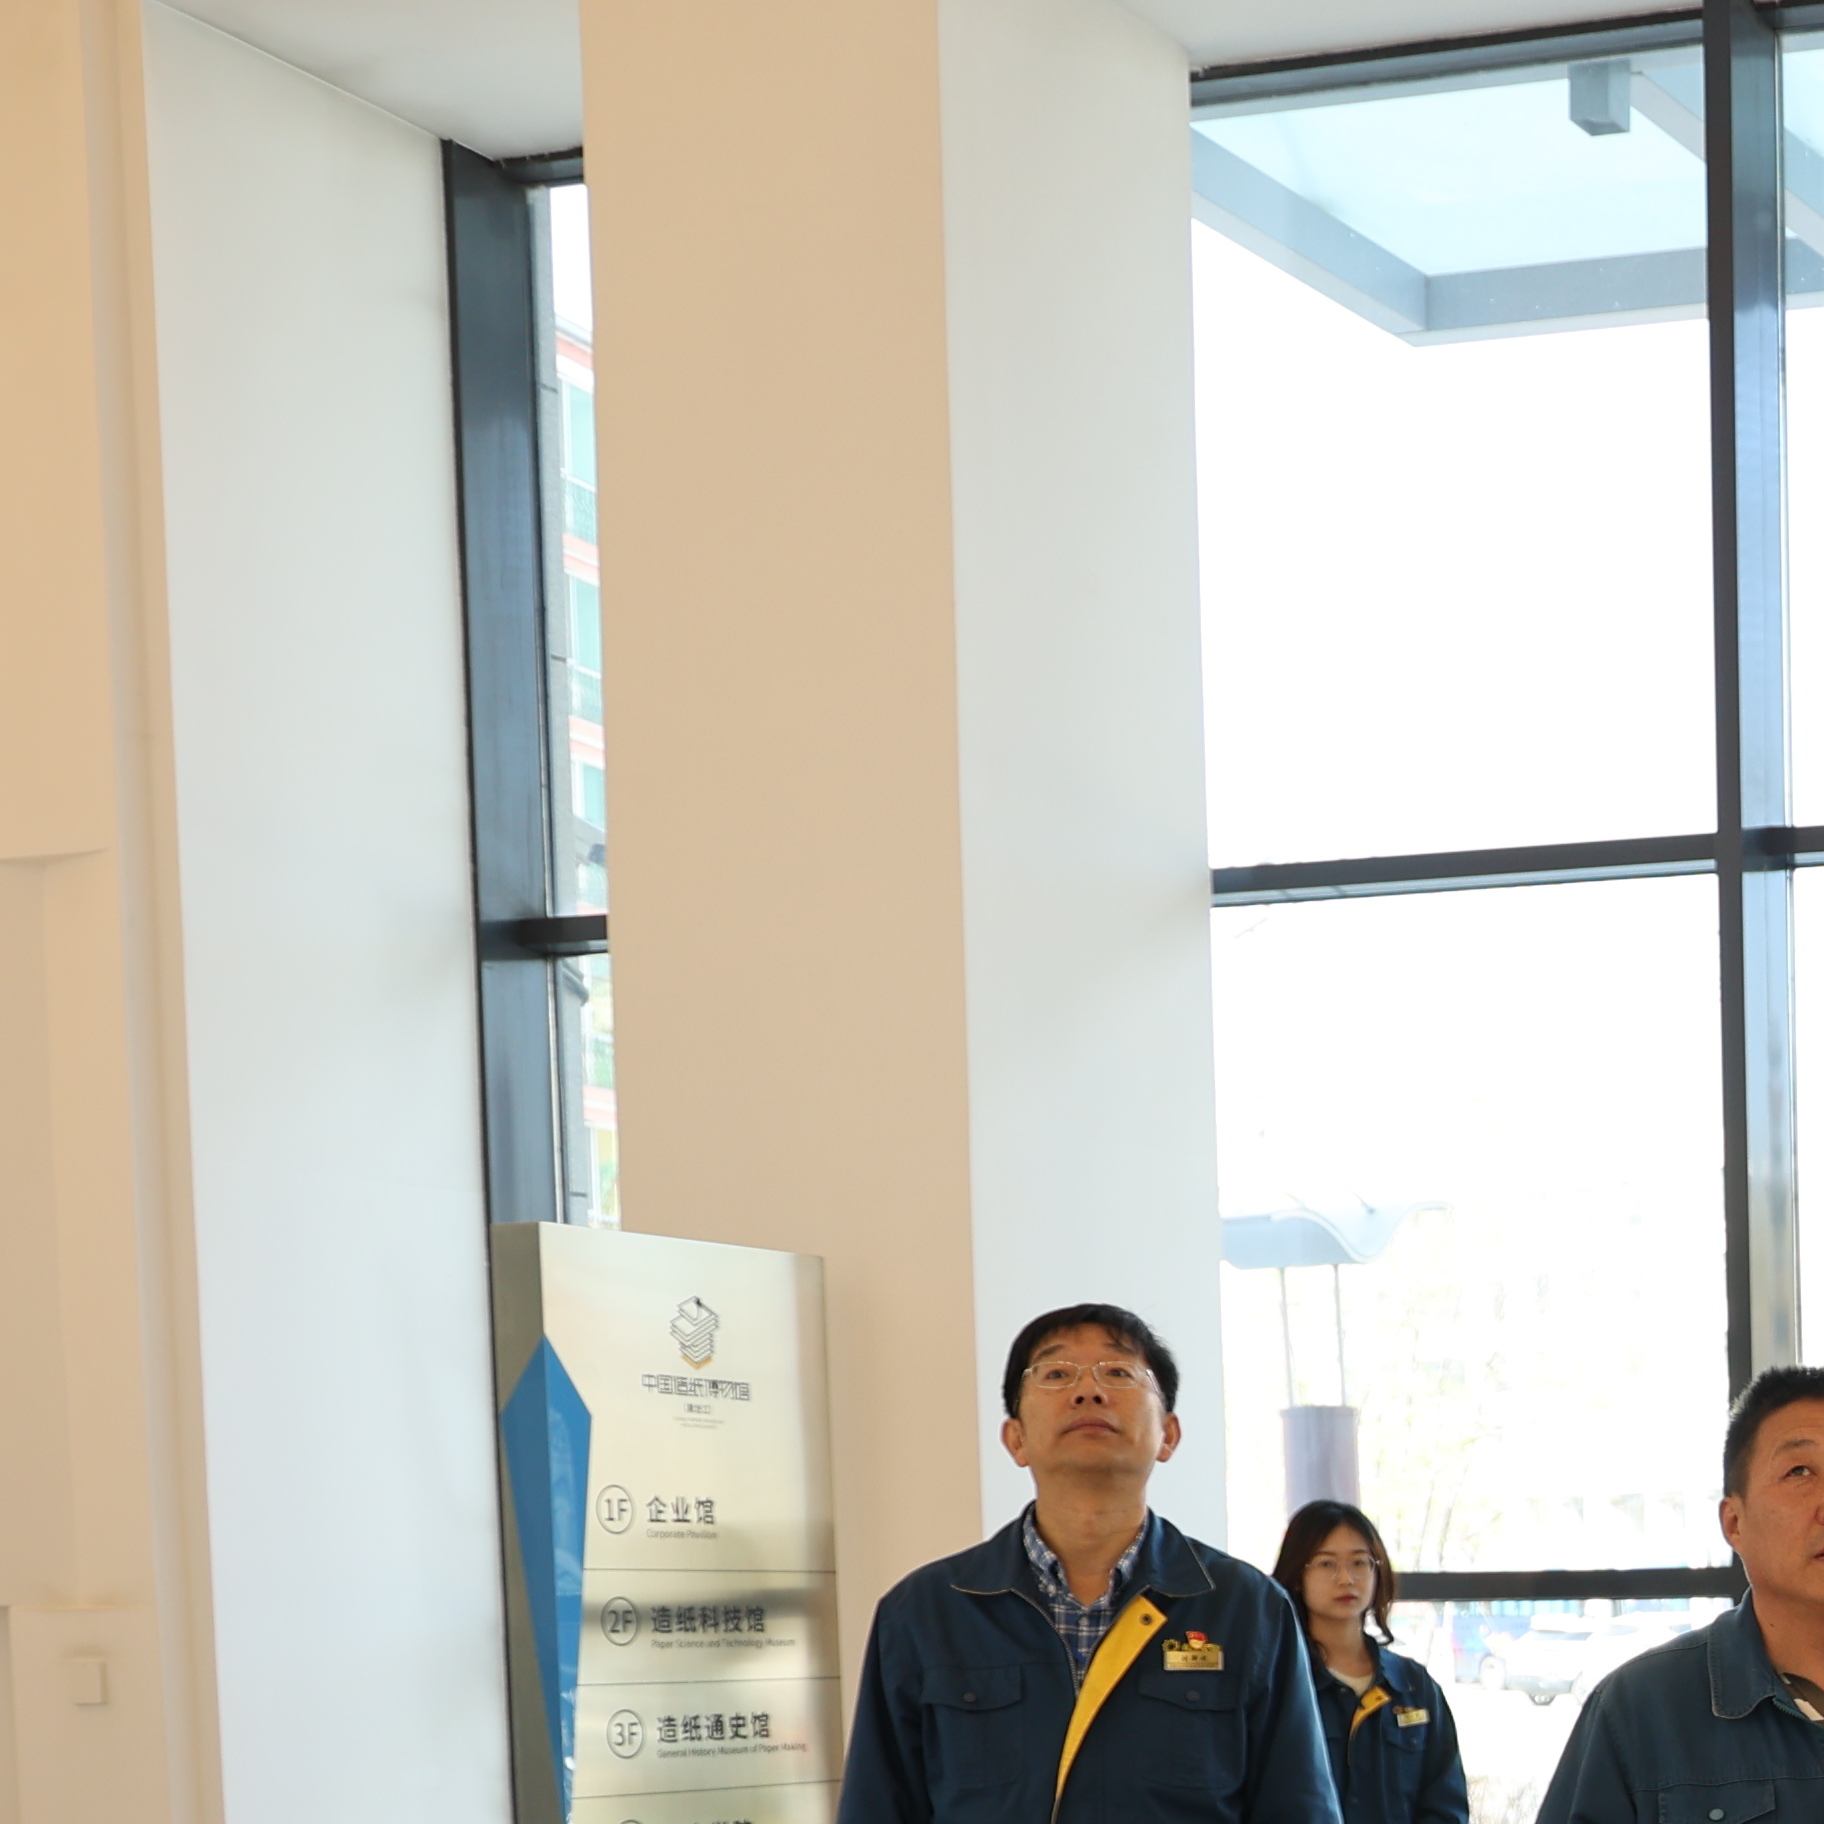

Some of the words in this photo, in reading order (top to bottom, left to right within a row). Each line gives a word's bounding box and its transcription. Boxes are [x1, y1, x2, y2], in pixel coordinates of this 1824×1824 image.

[604, 1499, 628, 1521] 1F
[646, 1496, 715, 1525] 企业馆
[608, 1610, 633, 1634] 2F
[651, 1605, 765, 1634] 造纸科技馆
[613, 1721, 638, 1746] 3F
[657, 1712, 770, 1743] 造纸通史馆
